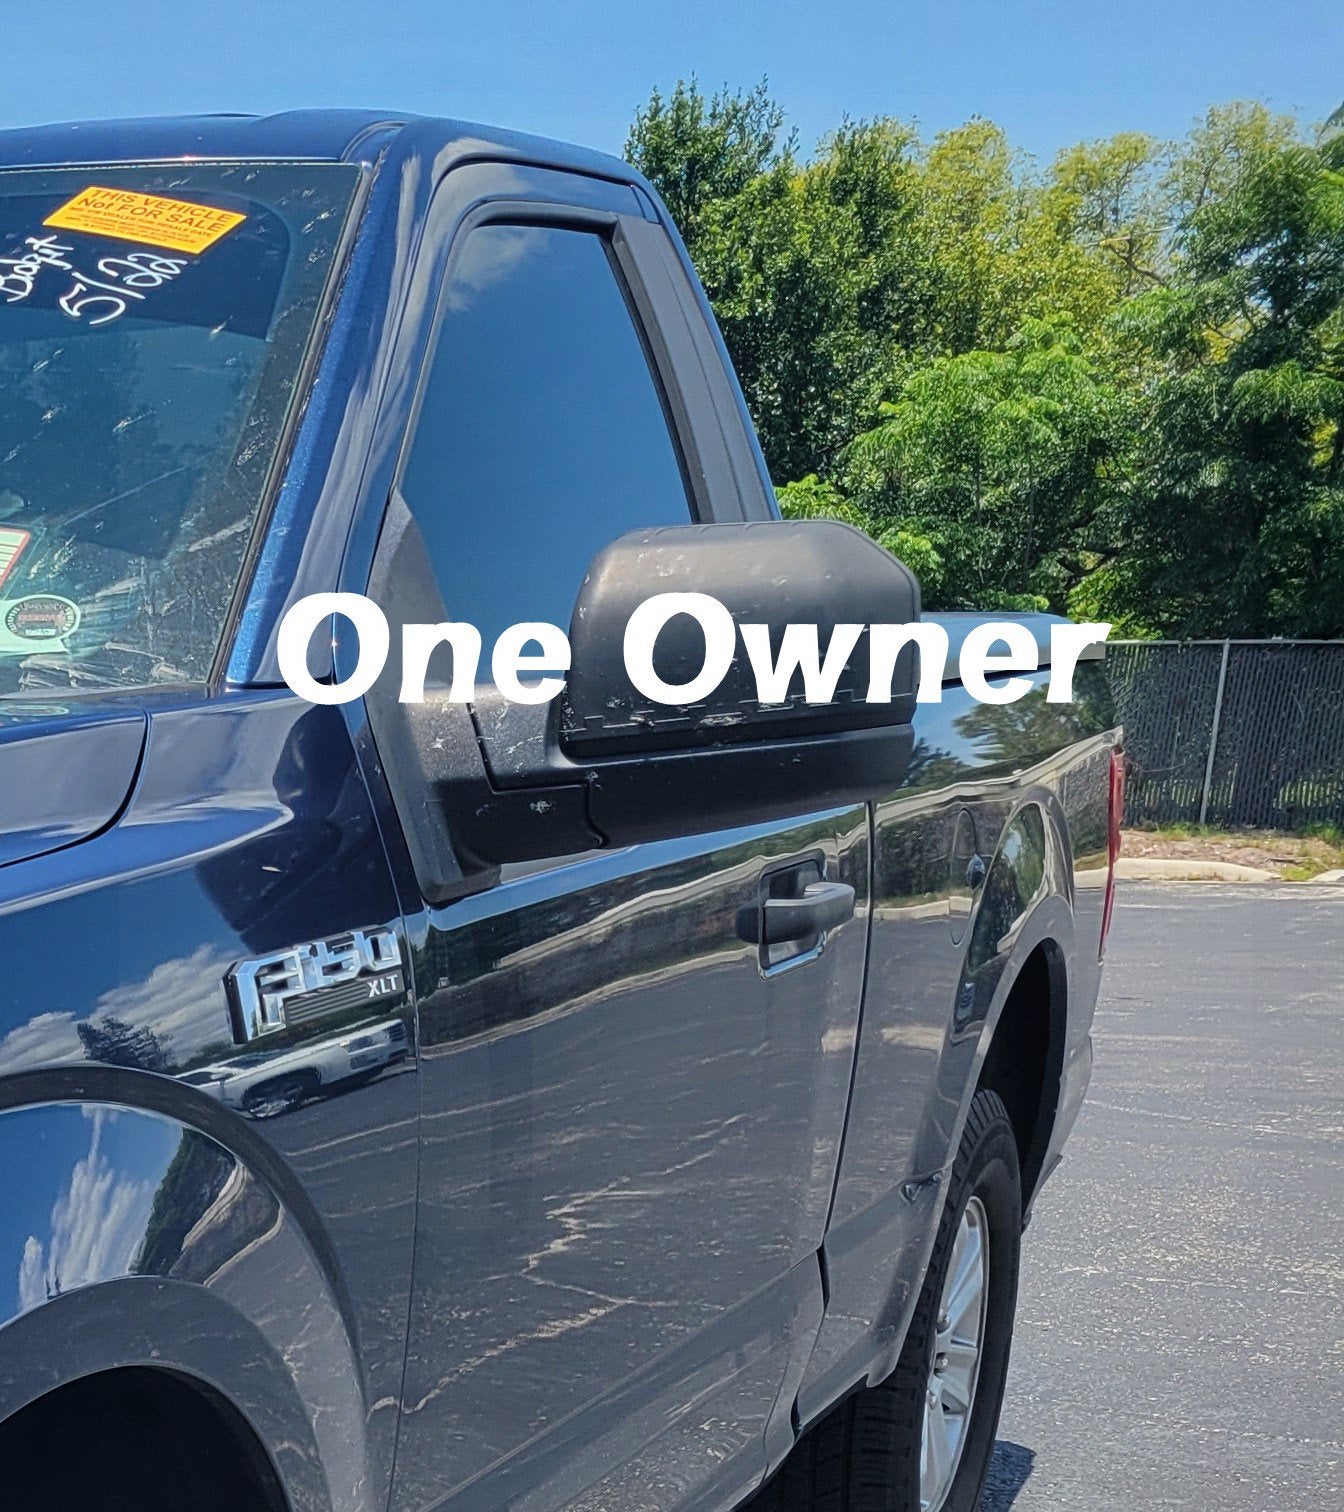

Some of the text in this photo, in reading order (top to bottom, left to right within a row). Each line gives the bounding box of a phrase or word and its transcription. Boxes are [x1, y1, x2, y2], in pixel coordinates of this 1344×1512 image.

[93, 189, 234, 224] THIS VEHICLE
[117, 202, 160, 219] FOR
[166, 212, 226, 233] SALE
[366, 974, 399, 998] XLT
